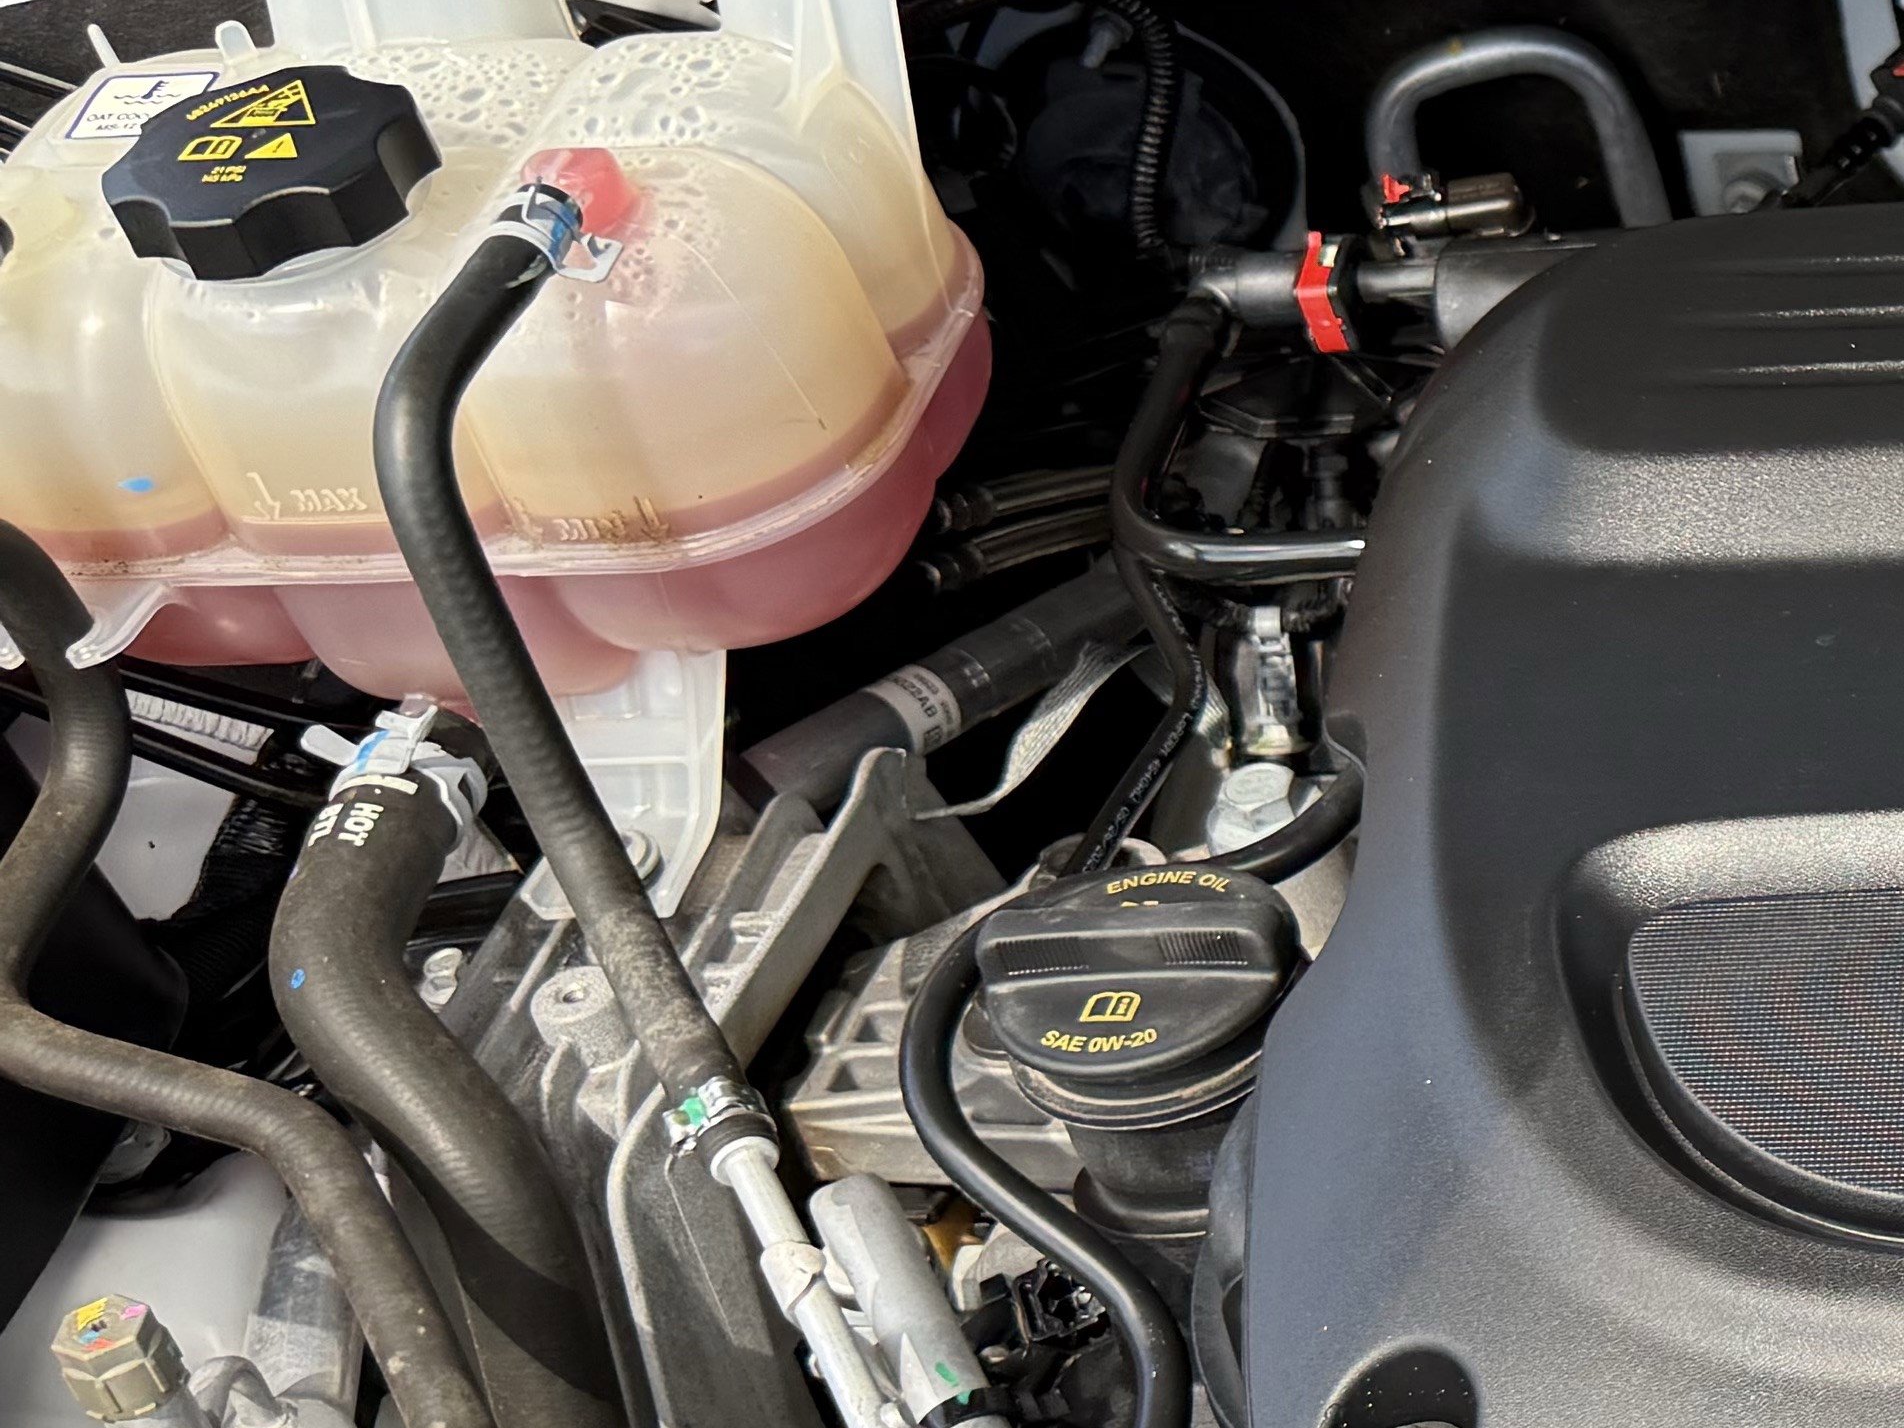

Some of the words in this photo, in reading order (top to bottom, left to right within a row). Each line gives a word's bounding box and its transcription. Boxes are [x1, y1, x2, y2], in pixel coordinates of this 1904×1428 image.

[290, 487, 368, 512] MAX
[553, 510, 628, 542] MIN
[338, 803, 384, 847] HOT
[1106, 870, 1196, 896] ENGINE
[1198, 872, 1232, 893] OIL
[1040, 1029, 1085, 1052] SAE
[1088, 1029, 1158, 1053] 0W-20
